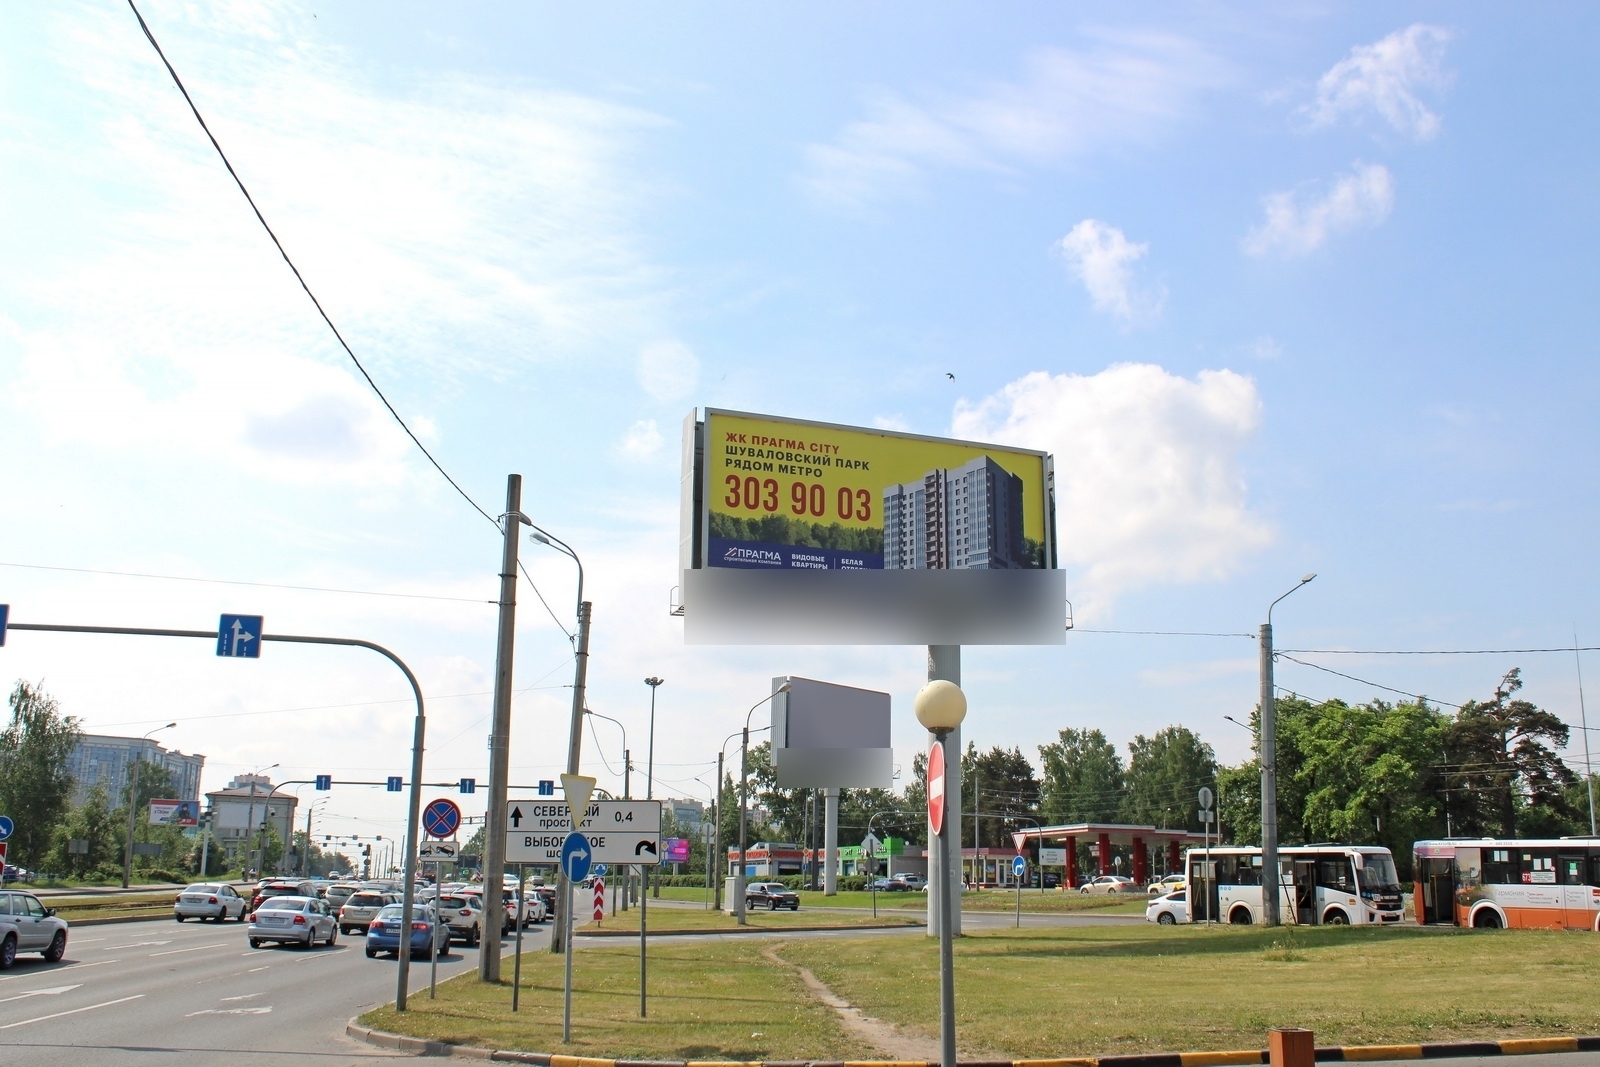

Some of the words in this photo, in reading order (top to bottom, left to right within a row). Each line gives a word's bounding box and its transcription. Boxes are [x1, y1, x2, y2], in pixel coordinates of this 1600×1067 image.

[726, 432, 746, 444] ЖК
[752, 436, 805, 450] ПРАГМА
[810, 443, 839, 454] CITY
[726, 445, 830, 466] ШУВАЛОВСКИЙ
[836, 459, 870, 471] ПАРК
[726, 458, 773, 472] РЯДОМ
[778, 464, 822, 477] МЕТРО
[725, 474, 778, 512] 303
[792, 482, 825, 516] 90
[838, 487, 871, 521] 03
[738, 548, 781, 561] ПРАГМА
[792, 554, 825, 562] ВИДОВЫЕ
[534, 803, 599, 816] СЕВЕРЫЙ
[615, 811, 633, 823] 0,4
[540, 819, 592, 829] проспкт
[525, 836, 605, 847] ВЫБОРОЕ
